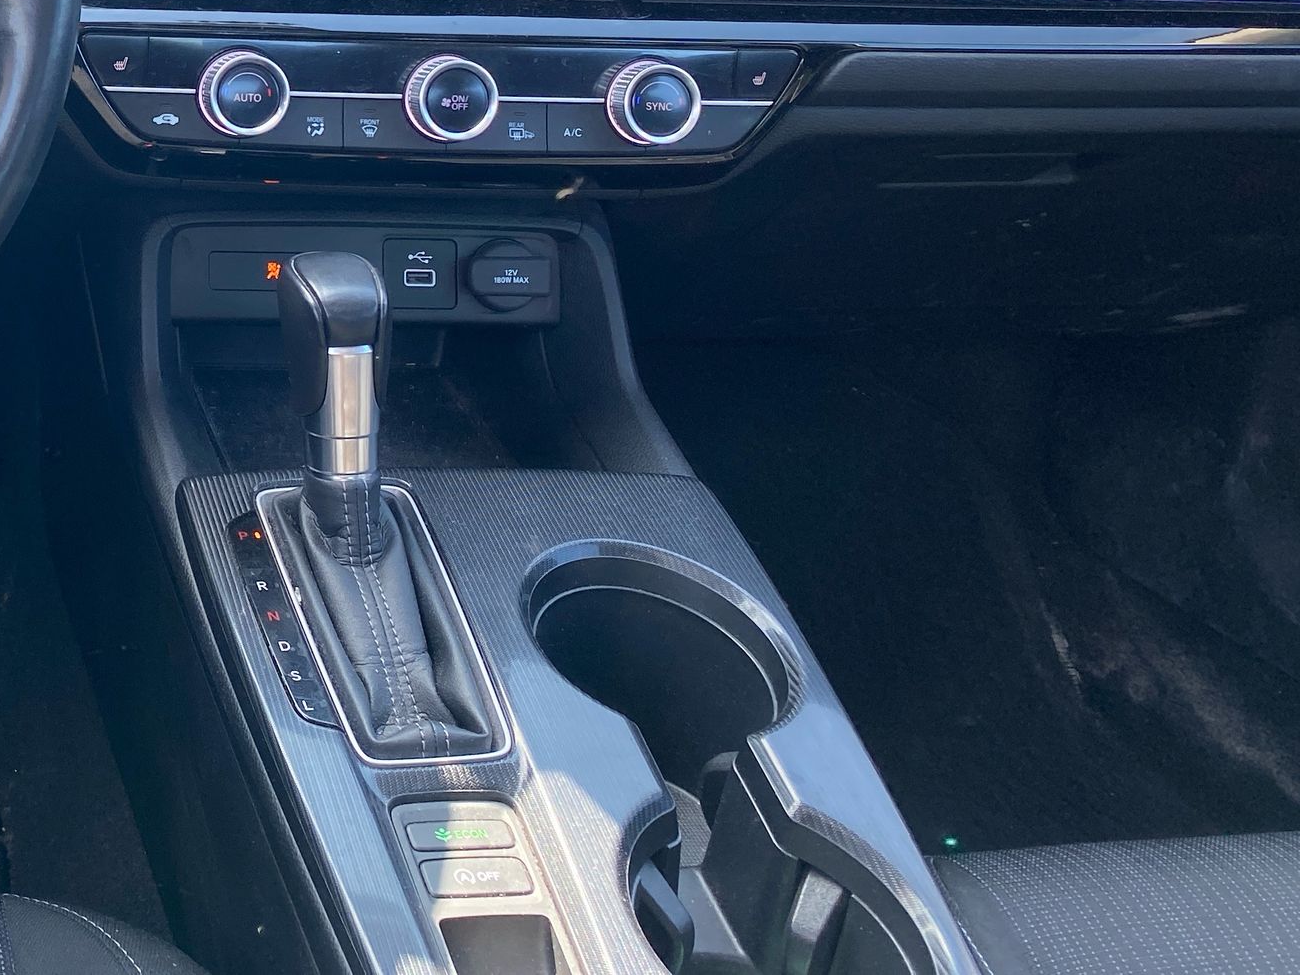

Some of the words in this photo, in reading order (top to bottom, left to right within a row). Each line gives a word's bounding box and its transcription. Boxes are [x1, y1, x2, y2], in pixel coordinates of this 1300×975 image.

[233, 93, 262, 103] AUTO
[451, 94, 469, 103] ON/
[451, 102, 469, 111] OFF
[645, 102, 674, 112] SYNC
[563, 128, 583, 137] A/C
[493, 276, 512, 284] 180W
[512, 276, 530, 284] MAX
[236, 531, 248, 541] P
[256, 581, 269, 592] R
[266, 611, 281, 622] N
[278, 641, 291, 652] D
[290, 670, 302, 682] S
[302, 700, 314, 712] L
[453, 828, 489, 840] ECON
[476, 871, 501, 882] OFF
